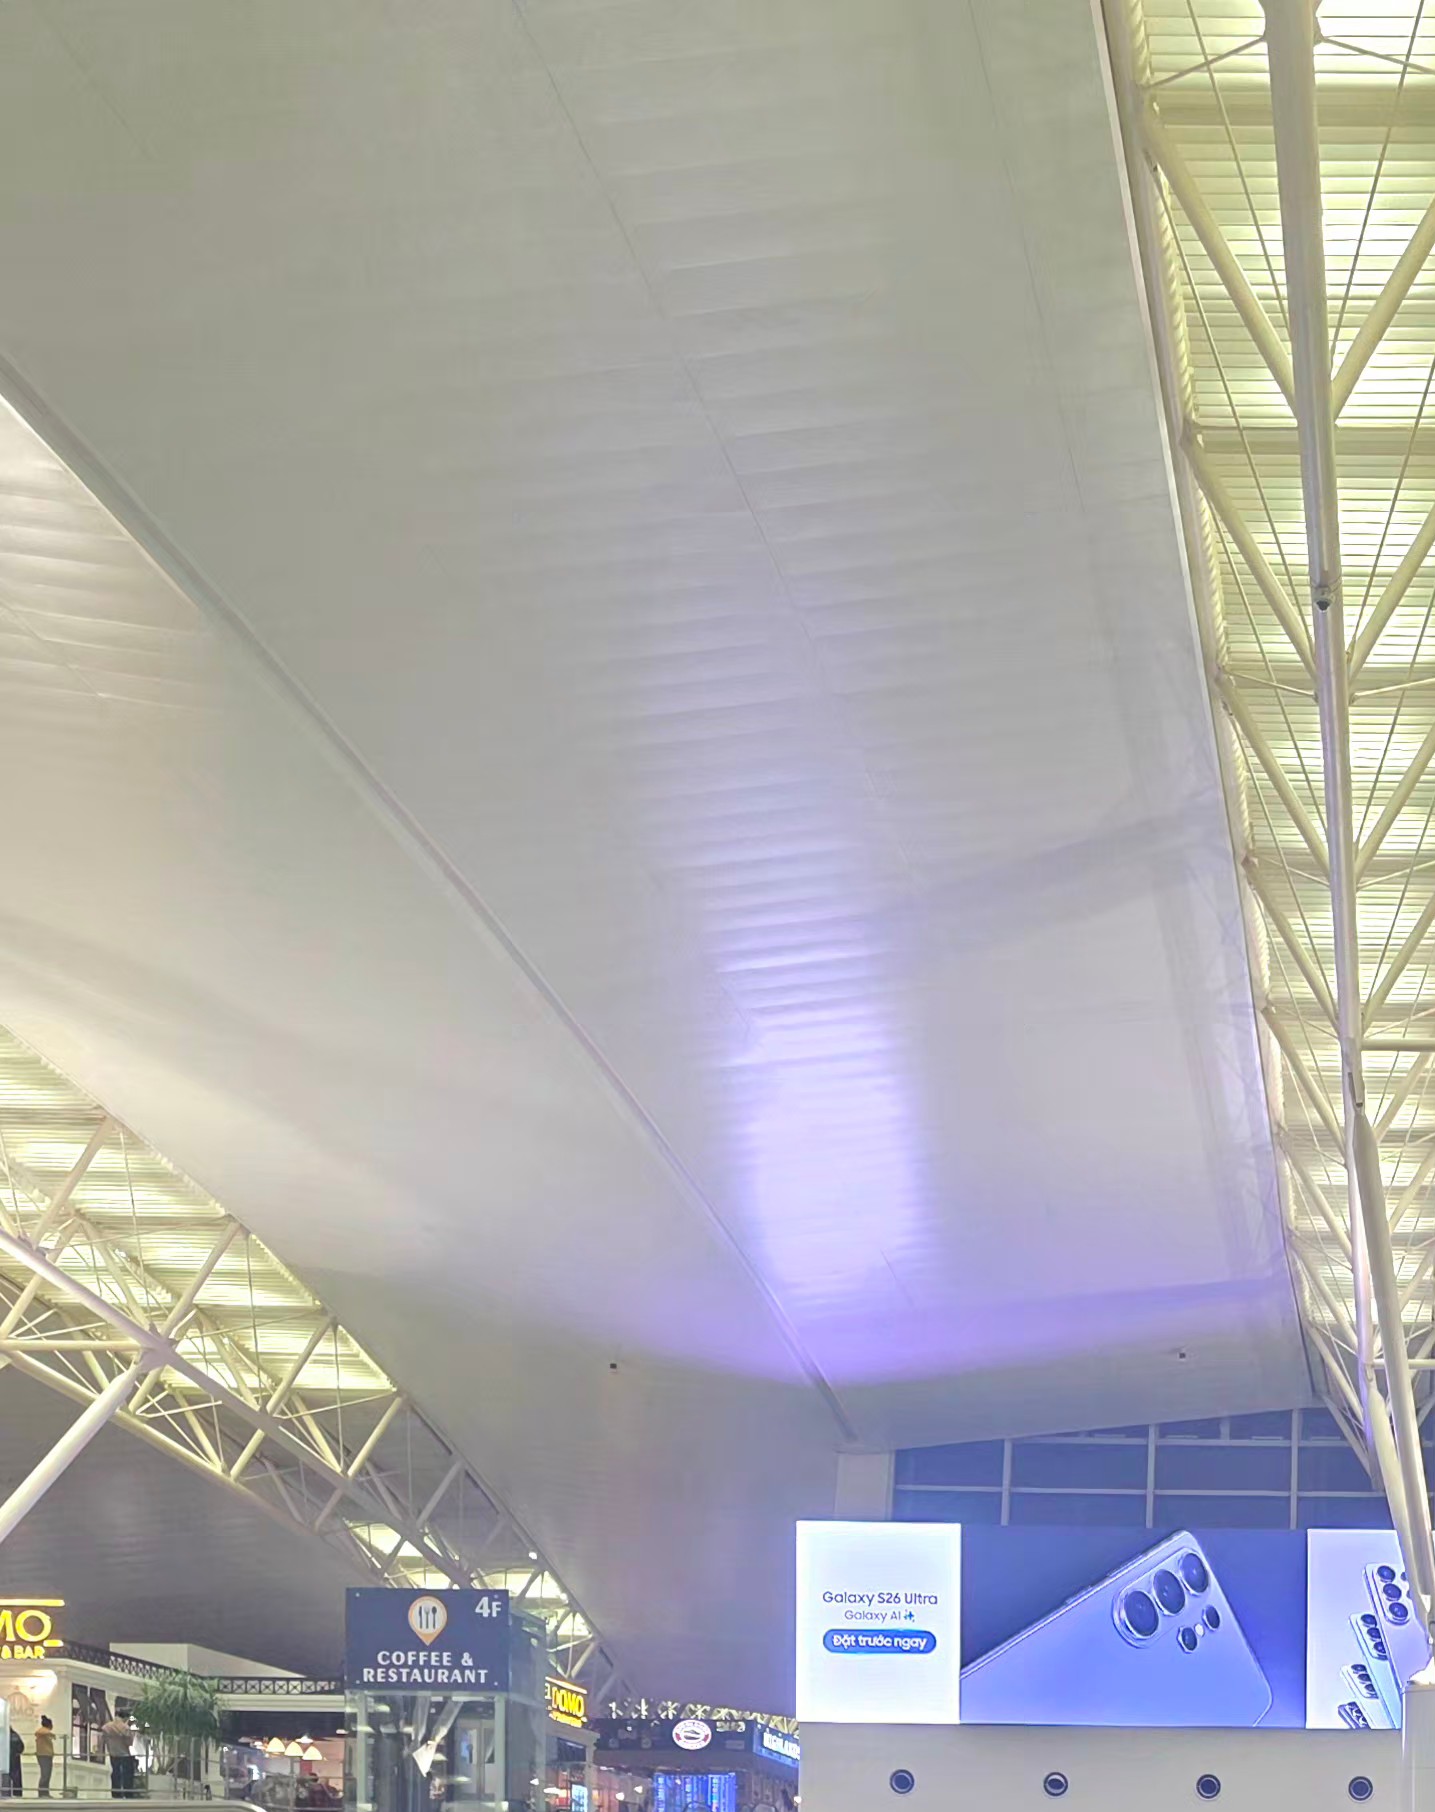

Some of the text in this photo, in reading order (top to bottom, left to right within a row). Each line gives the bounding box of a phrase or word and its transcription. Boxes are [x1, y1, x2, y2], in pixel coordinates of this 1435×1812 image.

[474, 1596, 502, 1618] 4F
[822, 1591, 938, 1607] Galaxy S26 Ultra
[844, 1609, 901, 1623] Galaxy AI
[832, 1634, 927, 1651] Đặt trước ngay
[13, 1645, 45, 1659] BAR
[377, 1651, 474, 1667] COFFEE &
[363, 1668, 488, 1684] RESTAURANT
[552, 1686, 585, 1718] DOMO
